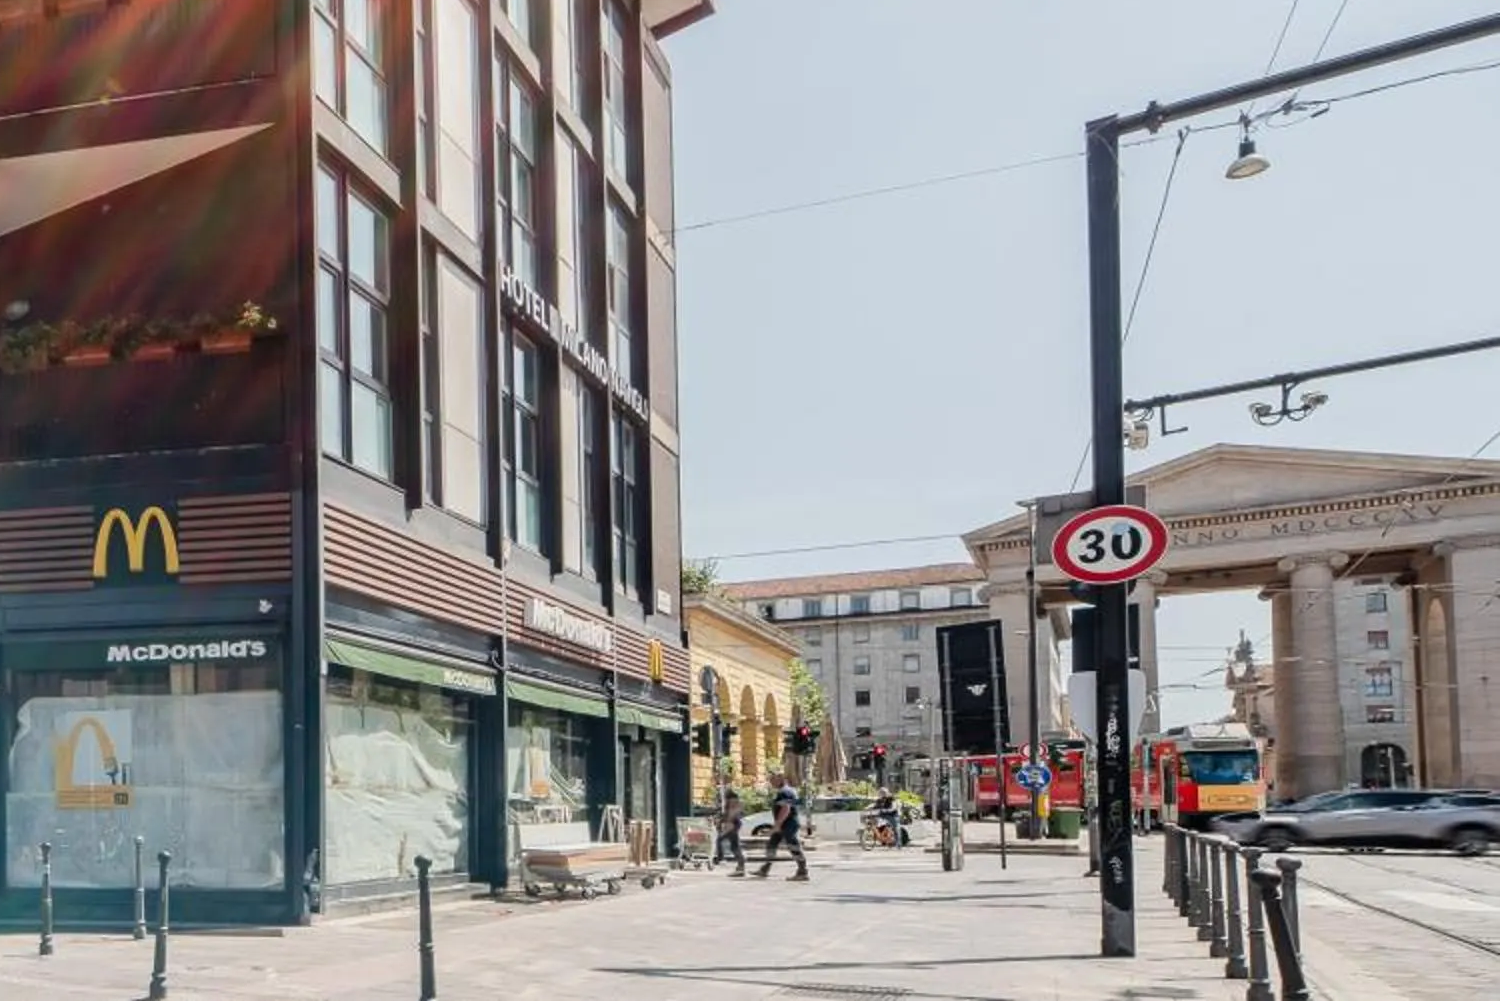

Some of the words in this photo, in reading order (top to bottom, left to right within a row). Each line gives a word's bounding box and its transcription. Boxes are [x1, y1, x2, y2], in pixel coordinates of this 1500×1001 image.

[501, 266, 549, 331] HOTEL
[1078, 523, 1143, 564] 30
[1172, 528, 1238, 546] NNO
[107, 640, 267, 662] McDonald's
